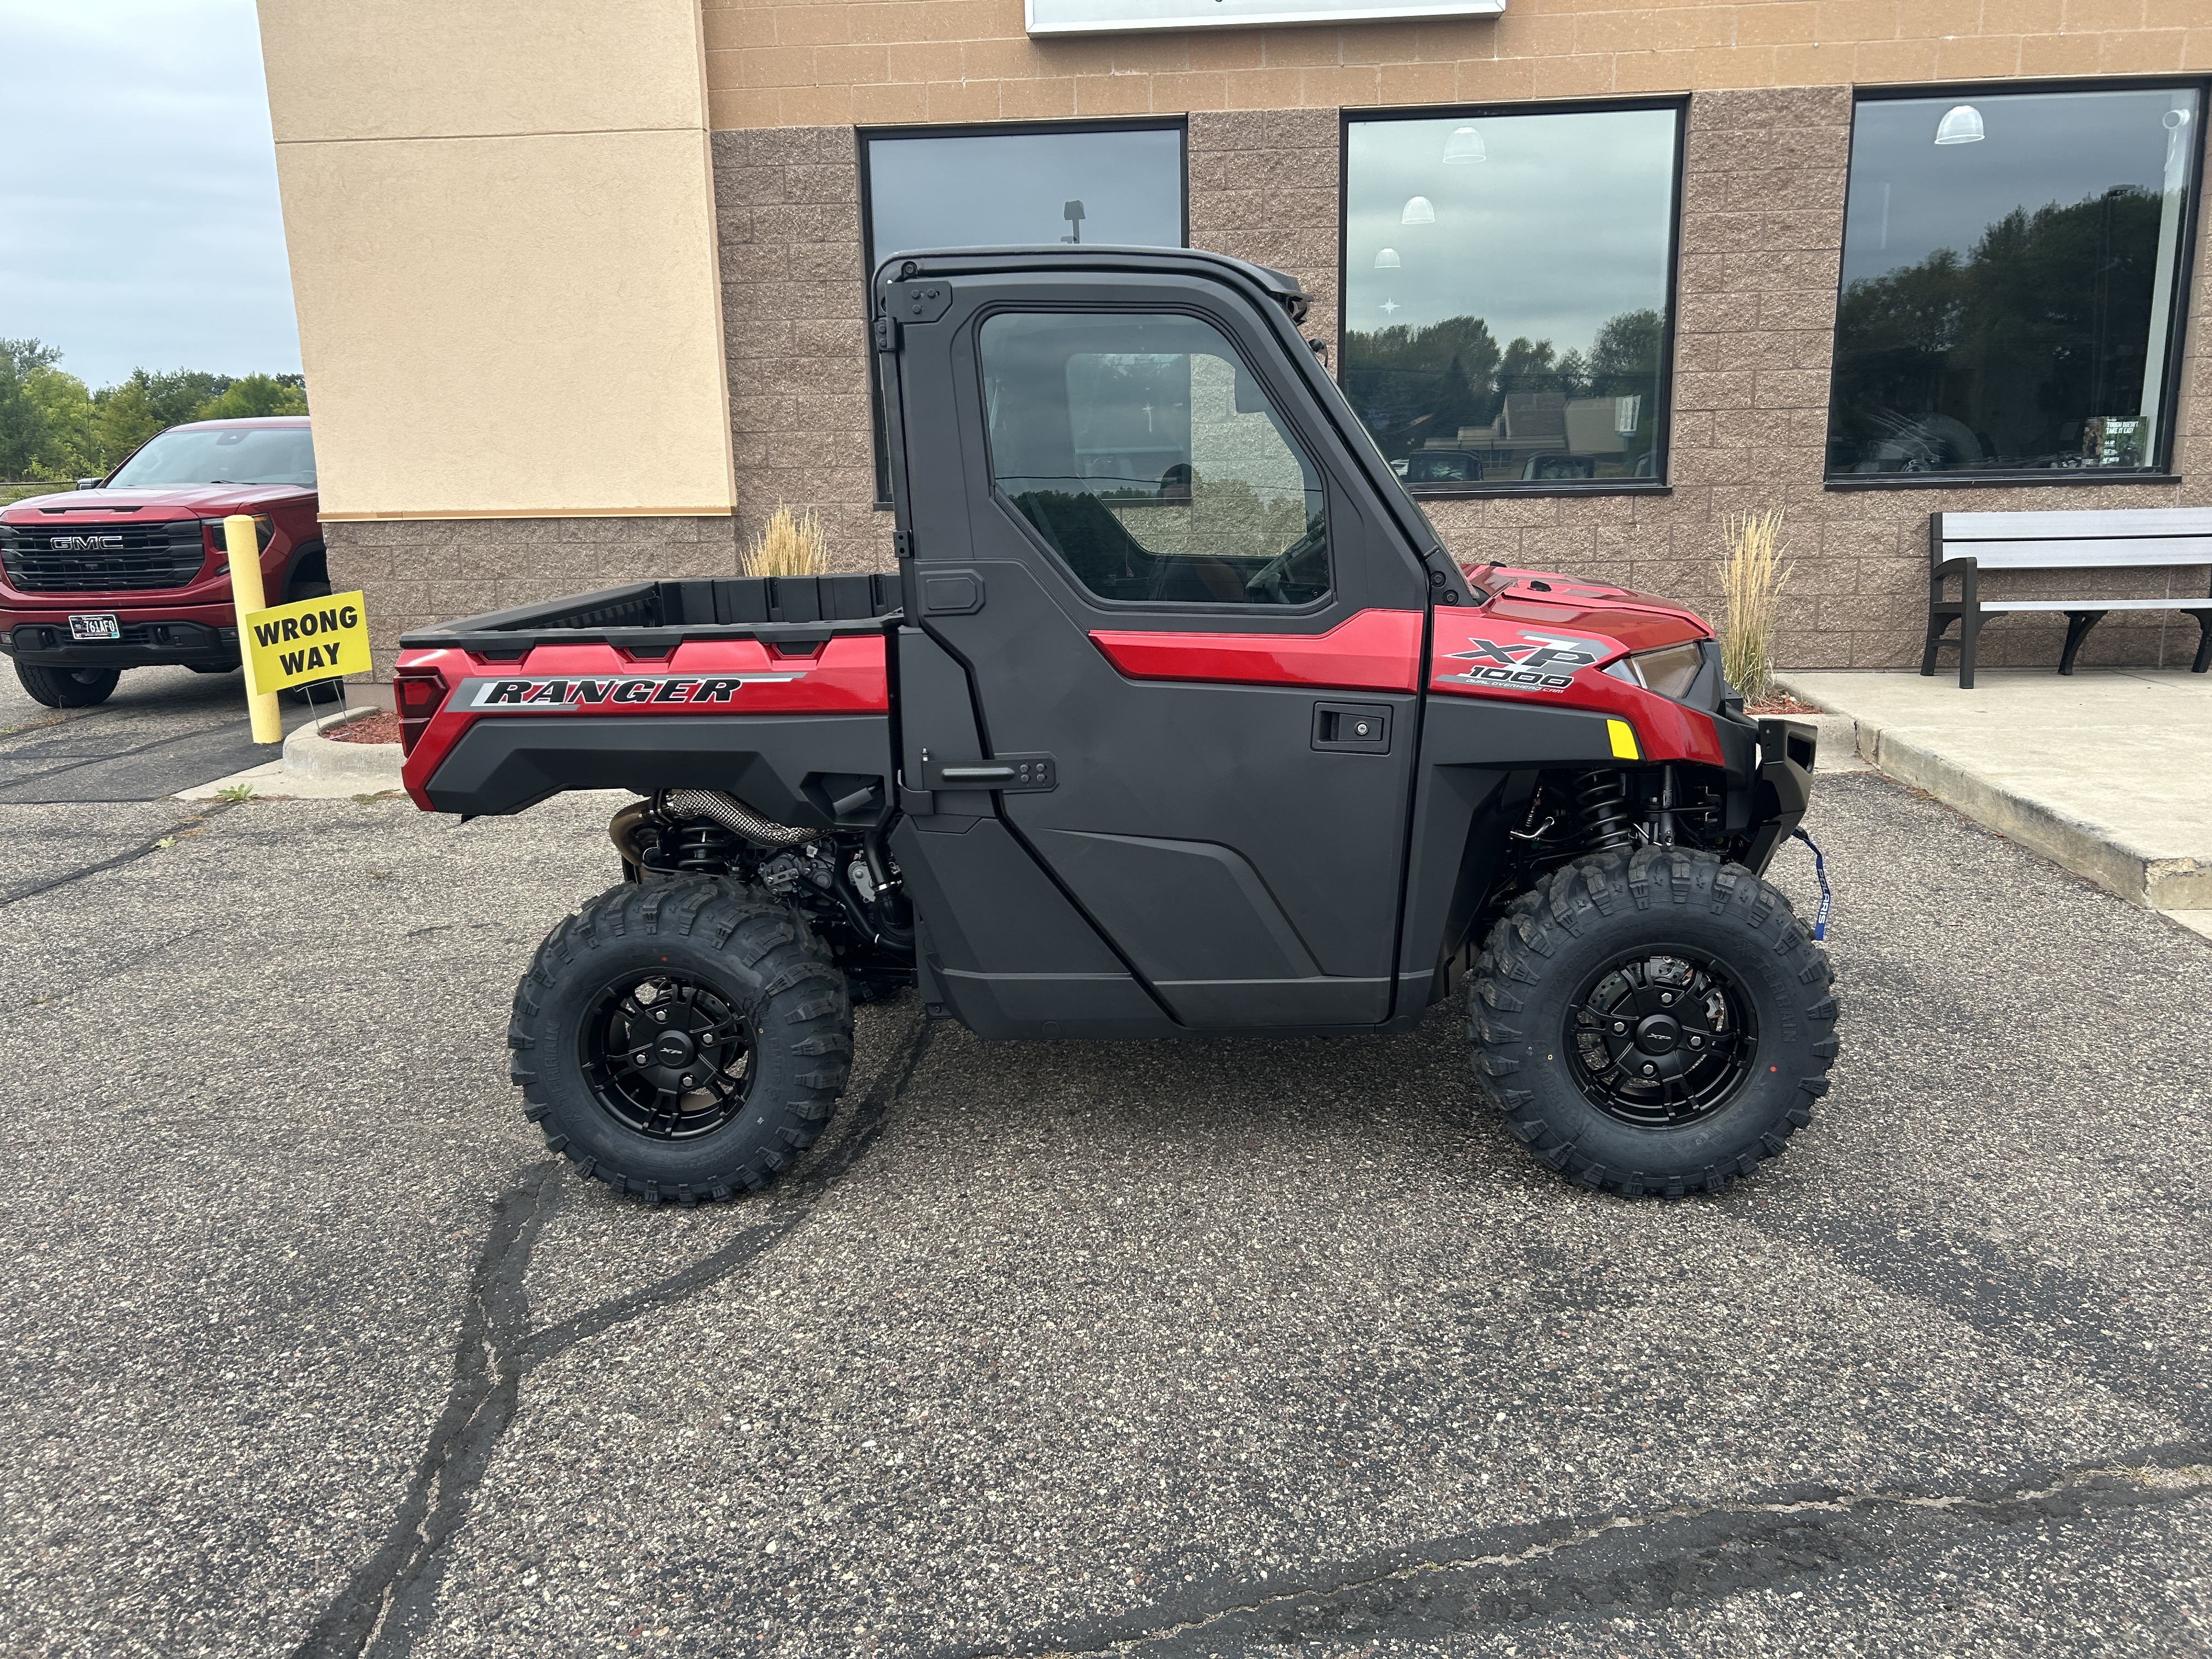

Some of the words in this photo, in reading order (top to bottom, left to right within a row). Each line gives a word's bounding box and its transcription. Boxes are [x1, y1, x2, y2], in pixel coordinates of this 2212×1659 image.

[50, 535, 123, 550] GMC
[253, 606, 358, 647] WRONG
[279, 642, 341, 676] WAY
[1440, 637, 1598, 668] XP
[483, 678, 743, 704] RANGER
[1468, 665, 1575, 689] 1000
[1491, 681, 1542, 691] OVERHEAD
[1817, 868, 1830, 924] POLARIS
[1733, 938, 1798, 1042] X-TERRAIN
[544, 1019, 584, 1127] X-TERRAIN
